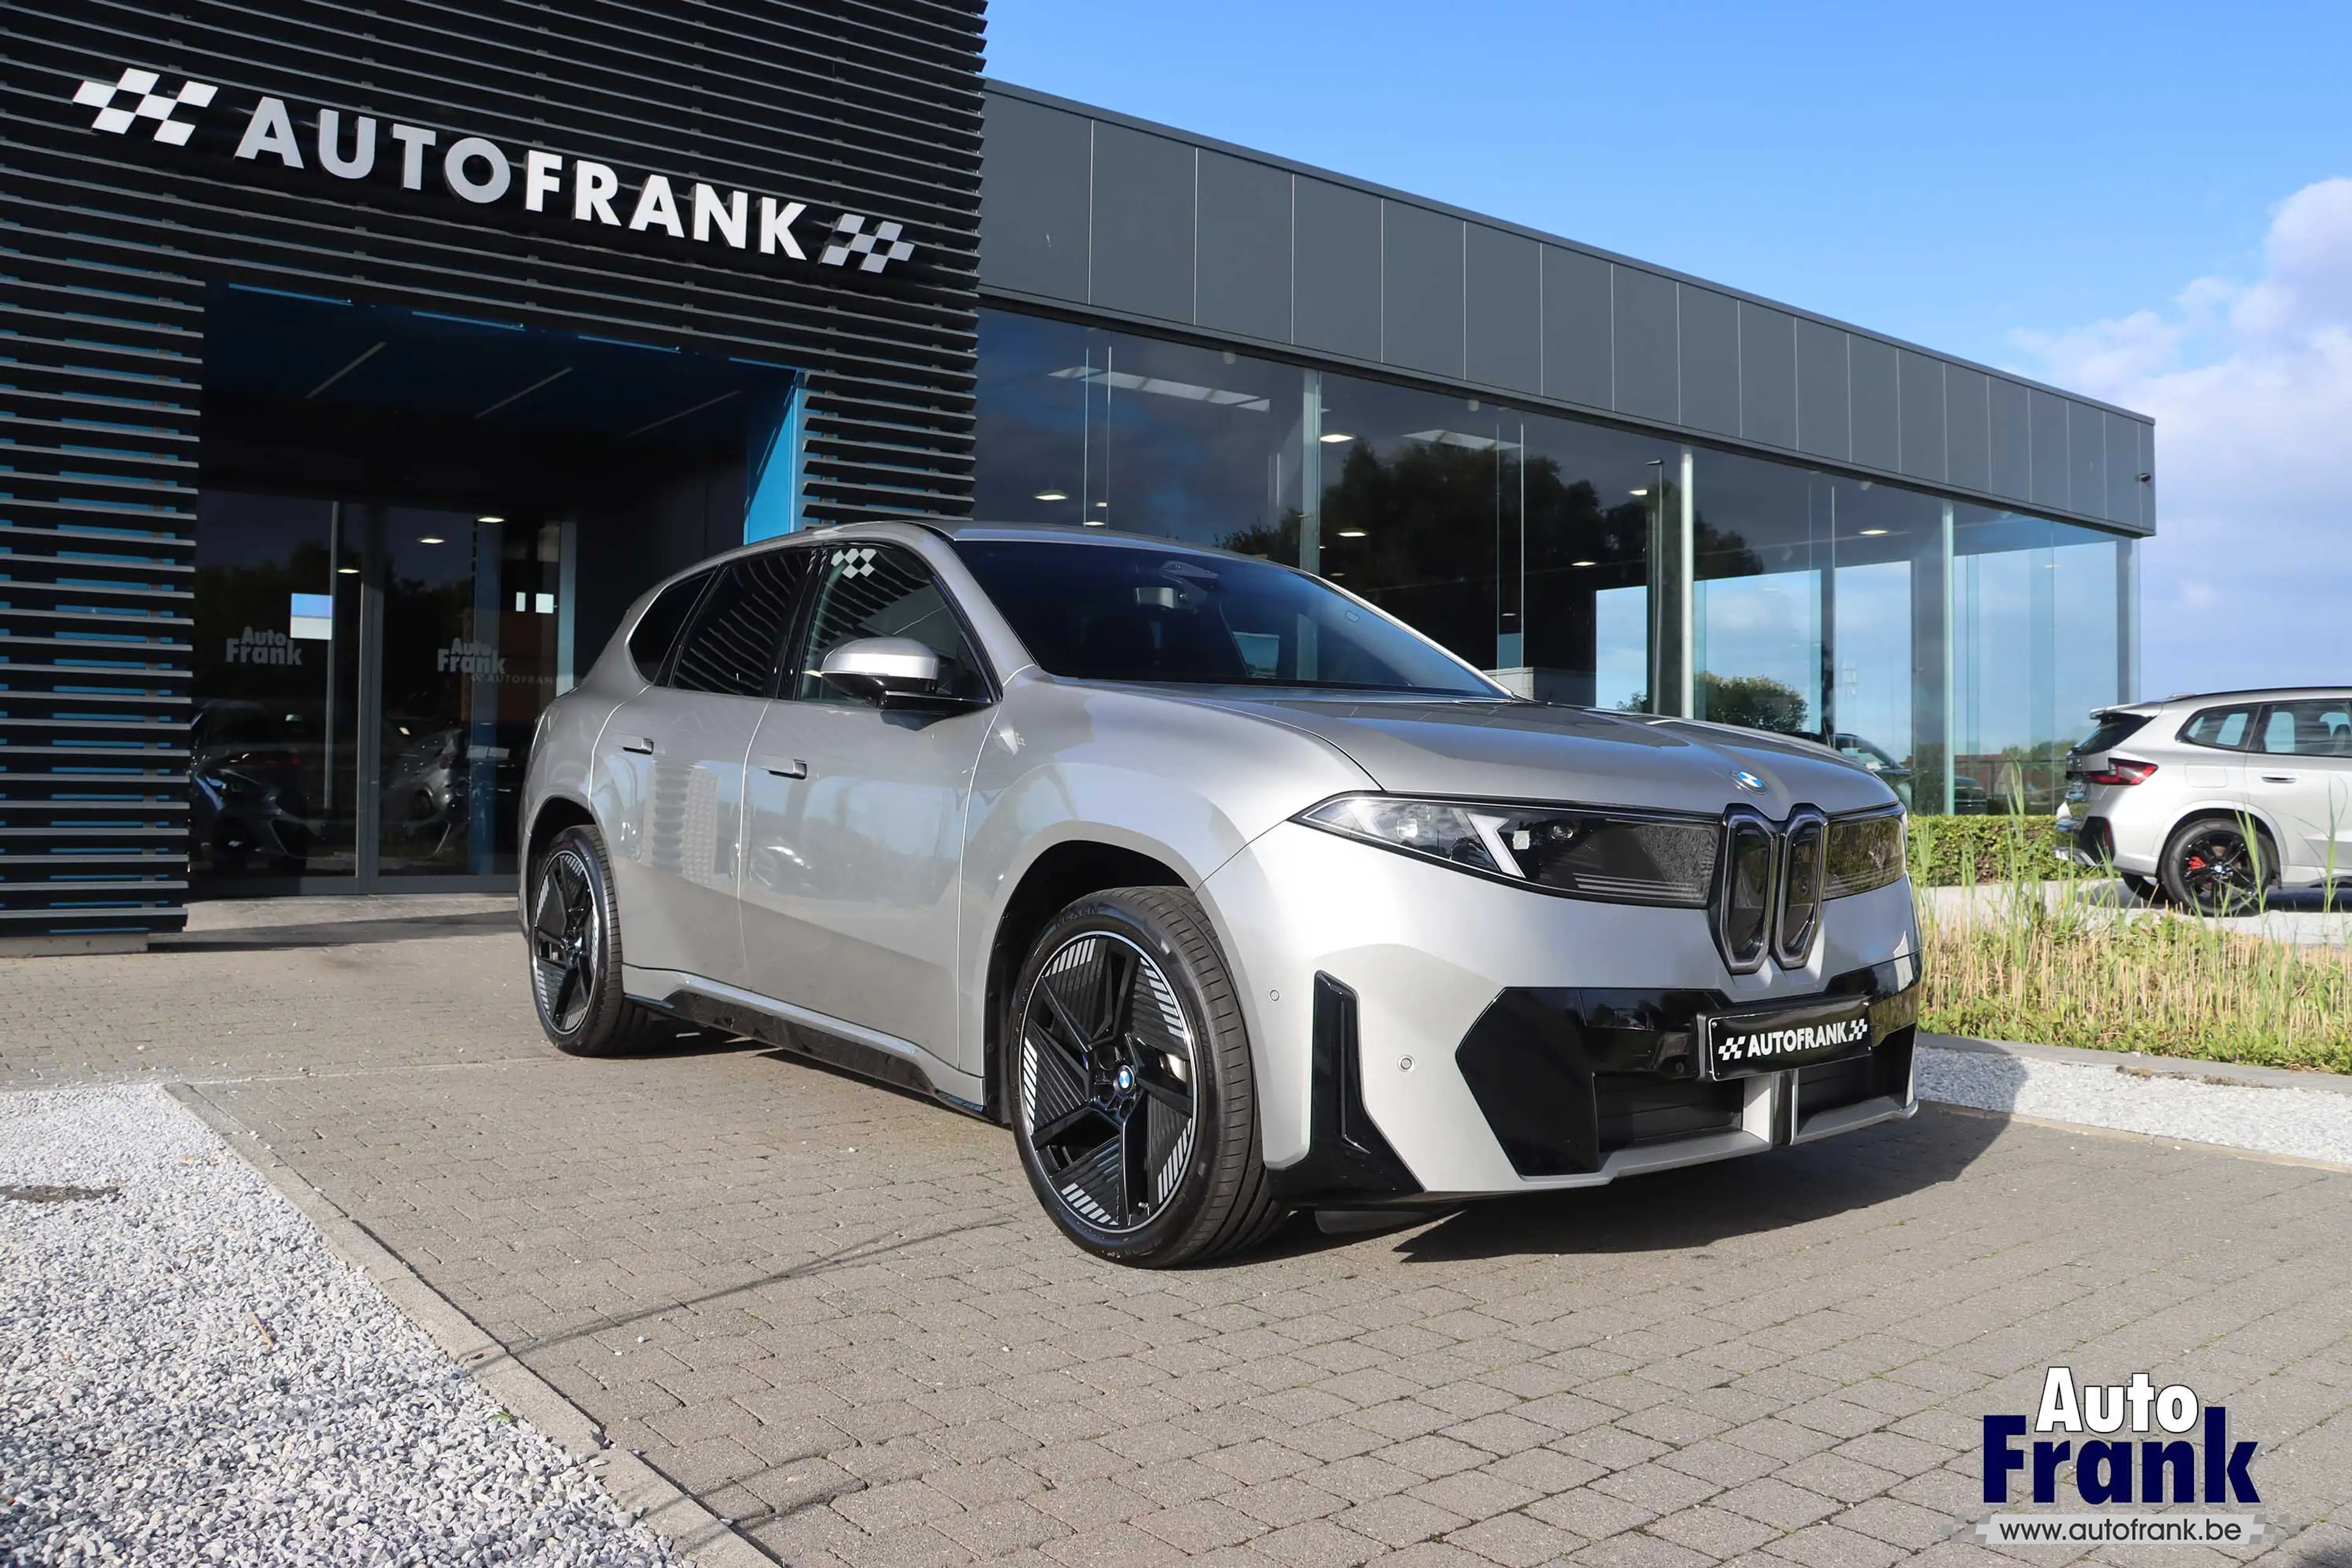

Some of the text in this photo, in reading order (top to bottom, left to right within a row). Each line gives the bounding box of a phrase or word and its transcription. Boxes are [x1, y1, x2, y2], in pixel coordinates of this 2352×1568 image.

[235, 96, 807, 261] AUTOFRANK
[241, 625, 287, 646] Auto
[451, 637, 492, 656] Auto
[225, 638, 303, 666] Frank
[437, 648, 506, 674] Frank
[487, 674, 554, 685] AUTOFRAN
[1747, 1020, 1848, 1058] AUTOFRANK
